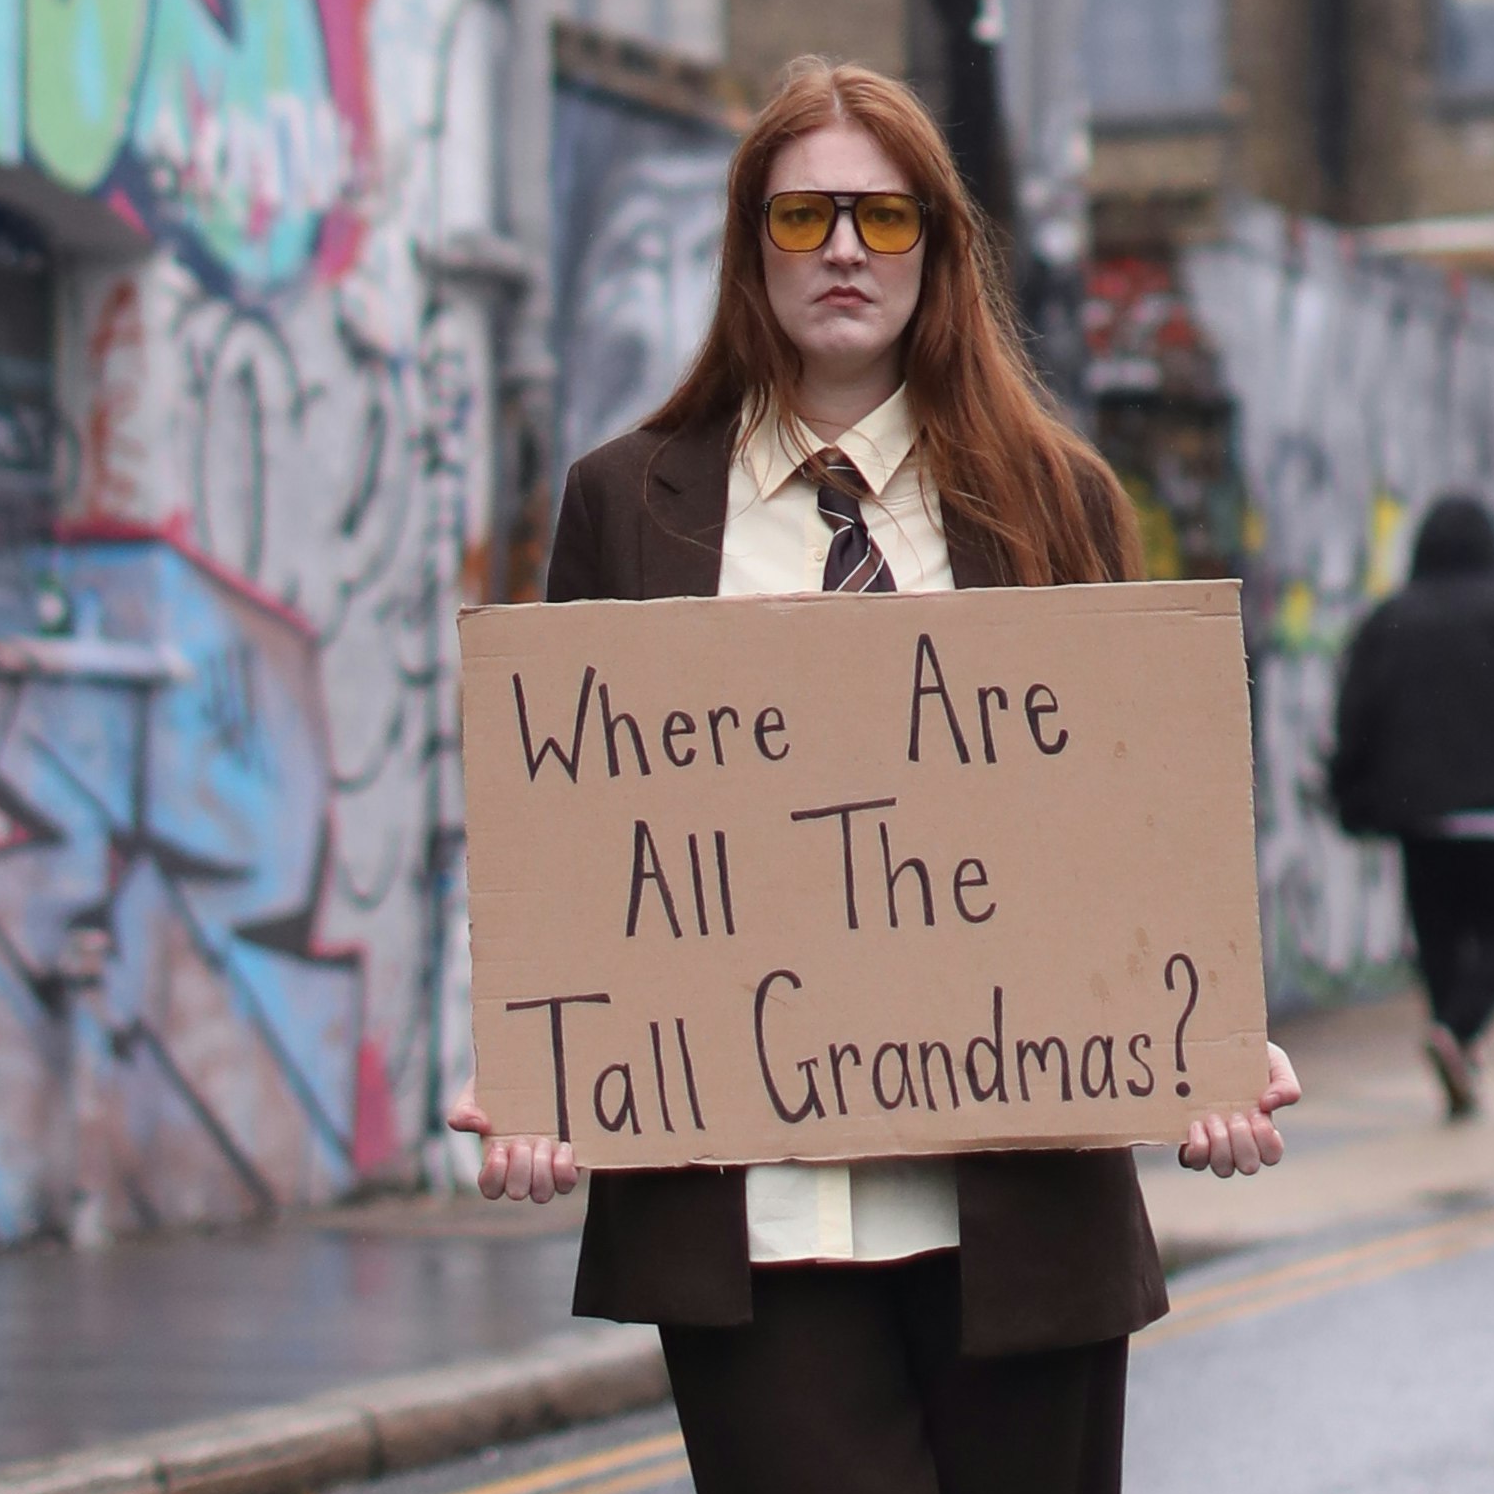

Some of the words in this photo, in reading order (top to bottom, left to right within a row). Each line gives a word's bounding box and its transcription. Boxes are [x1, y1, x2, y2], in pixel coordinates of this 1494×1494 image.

[512, 665, 791, 784] Where
[908, 633, 1069, 764] Are
[626, 819, 735, 938] All
[791, 797, 997, 930] The
[507, 992, 706, 1143] Tall
[753, 952, 1200, 1124] Grandmas?
